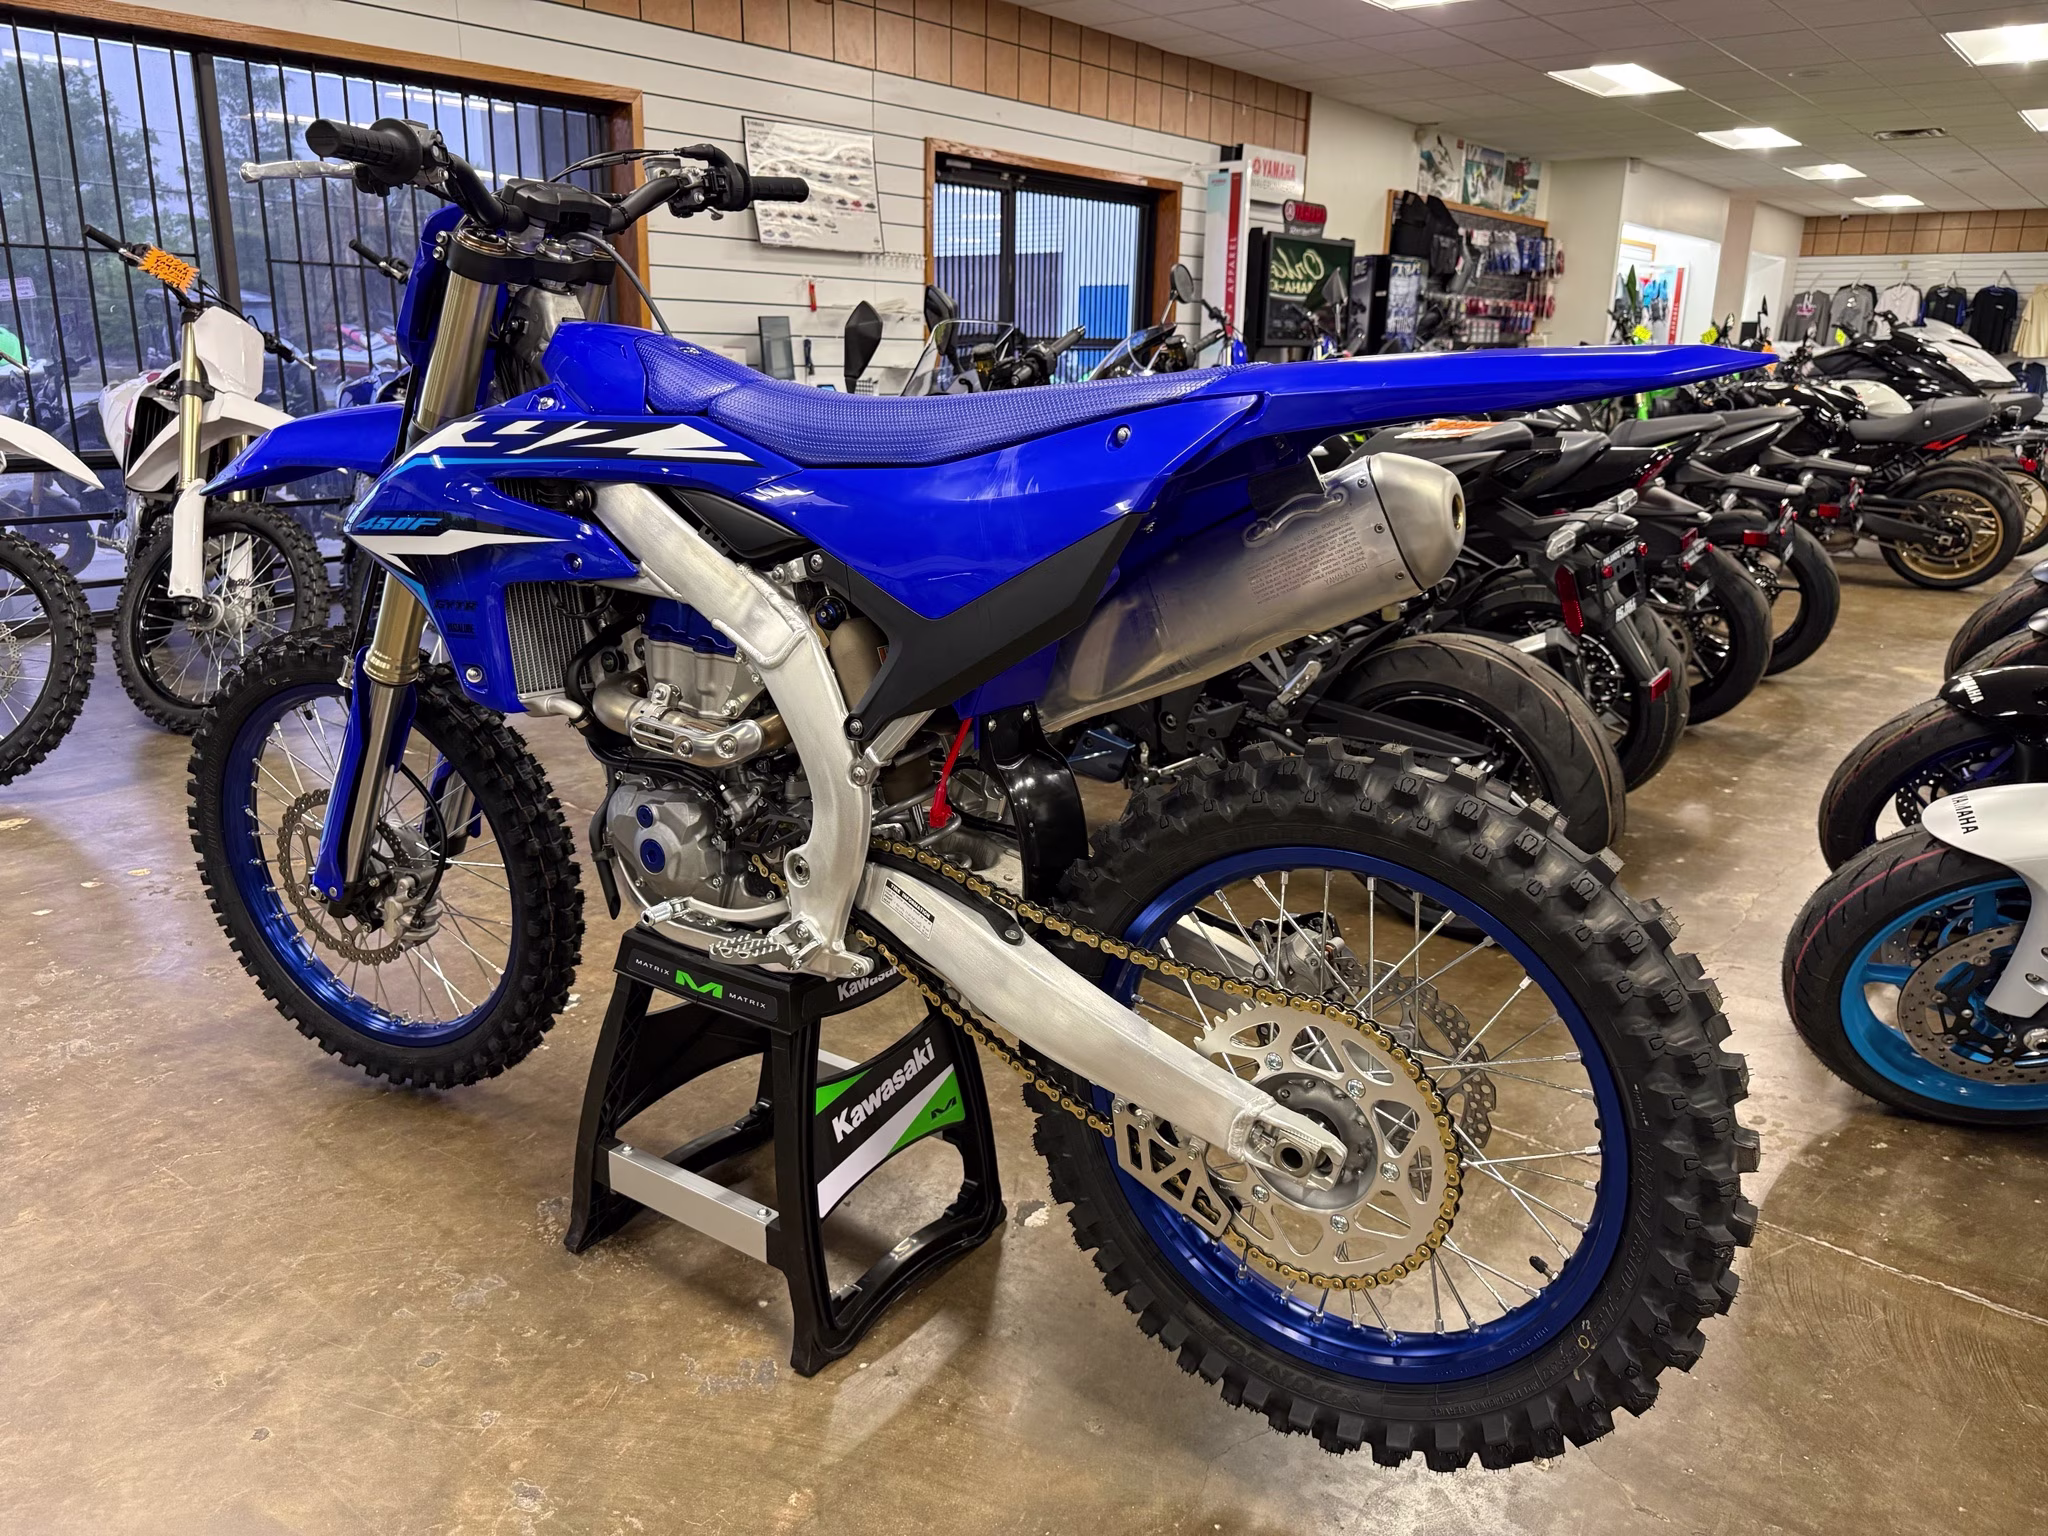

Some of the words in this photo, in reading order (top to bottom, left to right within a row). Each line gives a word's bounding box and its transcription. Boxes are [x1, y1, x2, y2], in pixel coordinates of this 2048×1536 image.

[1262, 158, 1296, 180] YAMAHA
[1227, 237, 1237, 294] APPAREL
[355, 516, 442, 531] 450F
[1320, 519, 1336, 530] ROAD
[1324, 569, 1351, 586] YAMAHA
[1951, 794, 1979, 835] YAMAHA
[901, 892, 931, 919] INFORMATION
[635, 958, 670, 976] MATRIX
[728, 992, 767, 1009] MATRIX
[831, 1036, 936, 1144] Kawasaki
